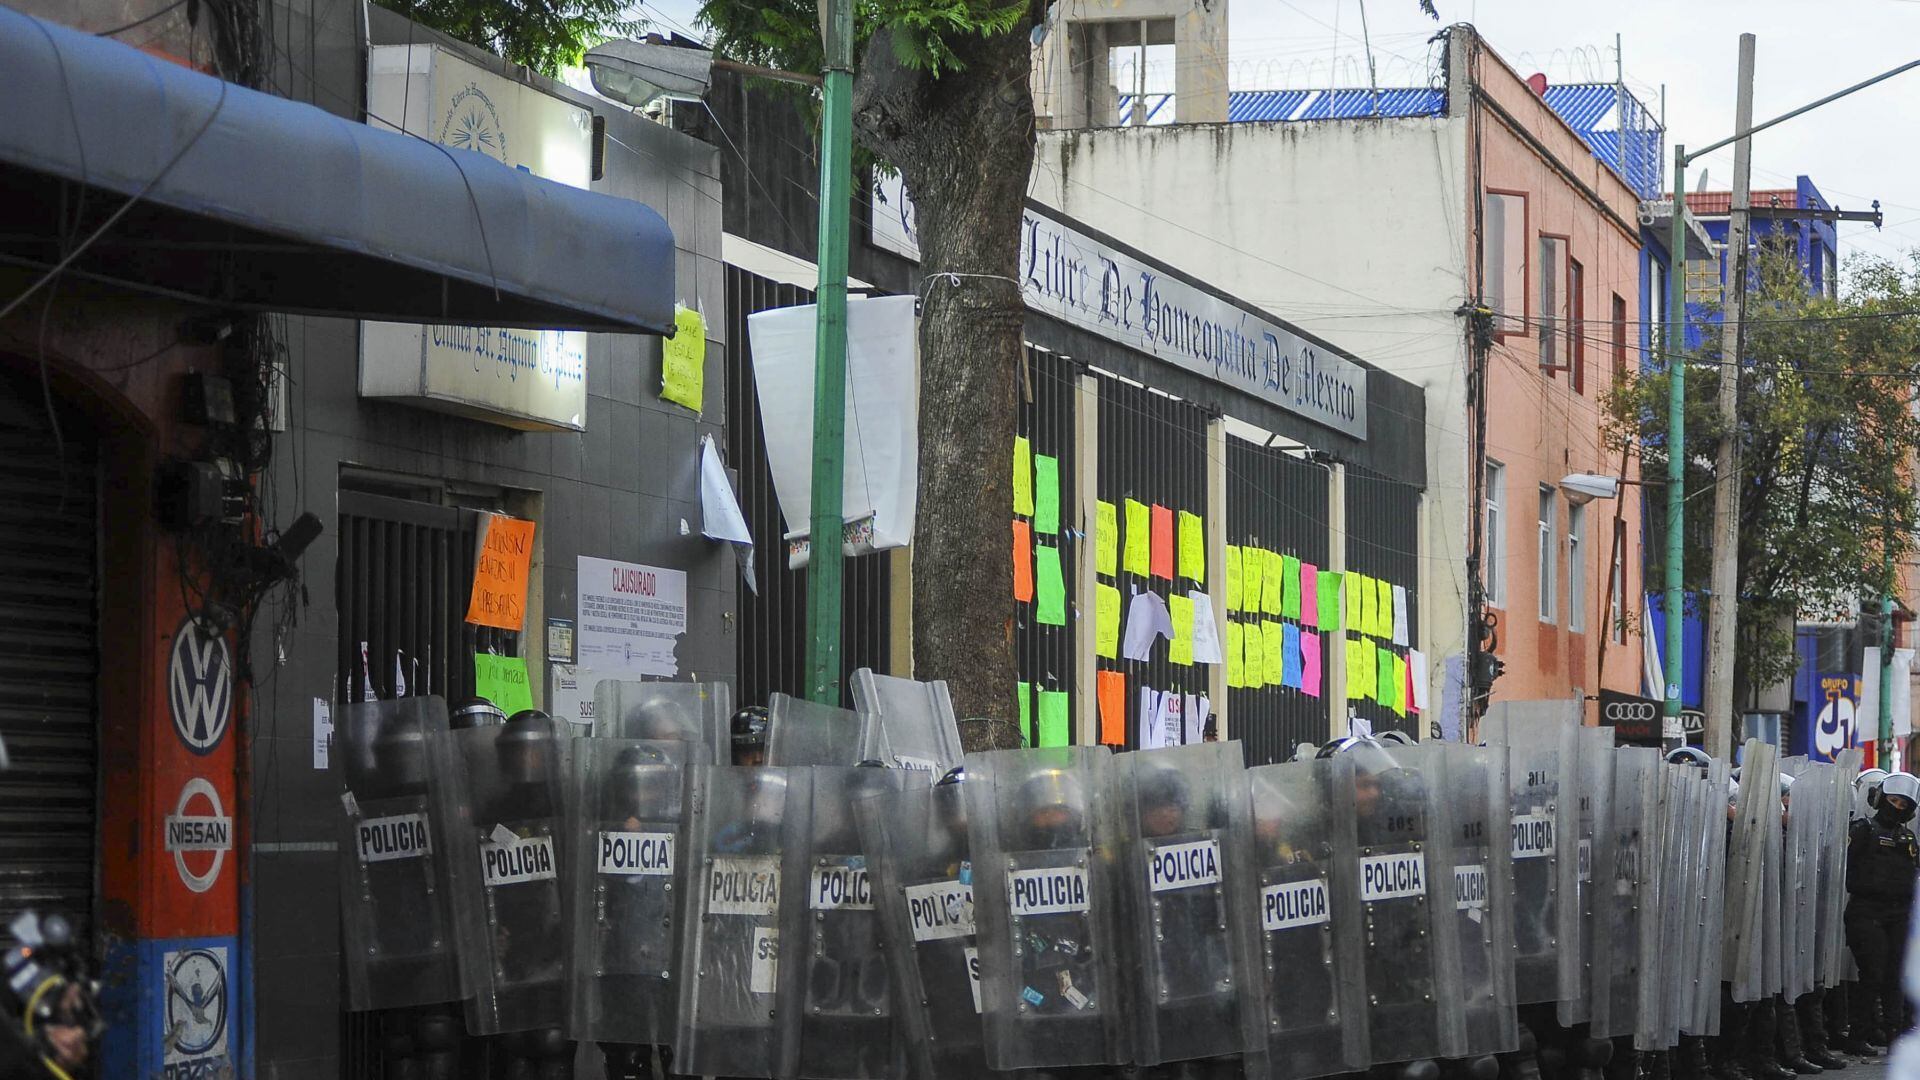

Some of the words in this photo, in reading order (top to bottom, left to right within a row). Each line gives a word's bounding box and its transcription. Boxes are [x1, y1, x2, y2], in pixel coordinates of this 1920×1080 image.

[1022, 214, 1090, 314] Libre
[1097, 250, 1133, 331] De
[1262, 328, 1291, 396] De
[612, 567, 656, 597] CLAUSURADO
[1821, 678, 1849, 689] GRUPO
[169, 822, 227, 844] NISSAN
[360, 820, 427, 855] POLICIA
[1511, 820, 1553, 851] POLICIA
[485, 843, 552, 879] POLICIA
[602, 838, 669, 868] POLICIA
[1153, 848, 1217, 884] POLICIA
[712, 871, 777, 903] POLICIA
[819, 871, 873, 905] POLIC
[1014, 874, 1085, 908] POLICIA
[1365, 859, 1422, 894] POLICIA
[1456, 872, 1486, 902] OLICIA
[1266, 886, 1325, 922] POLICIA
